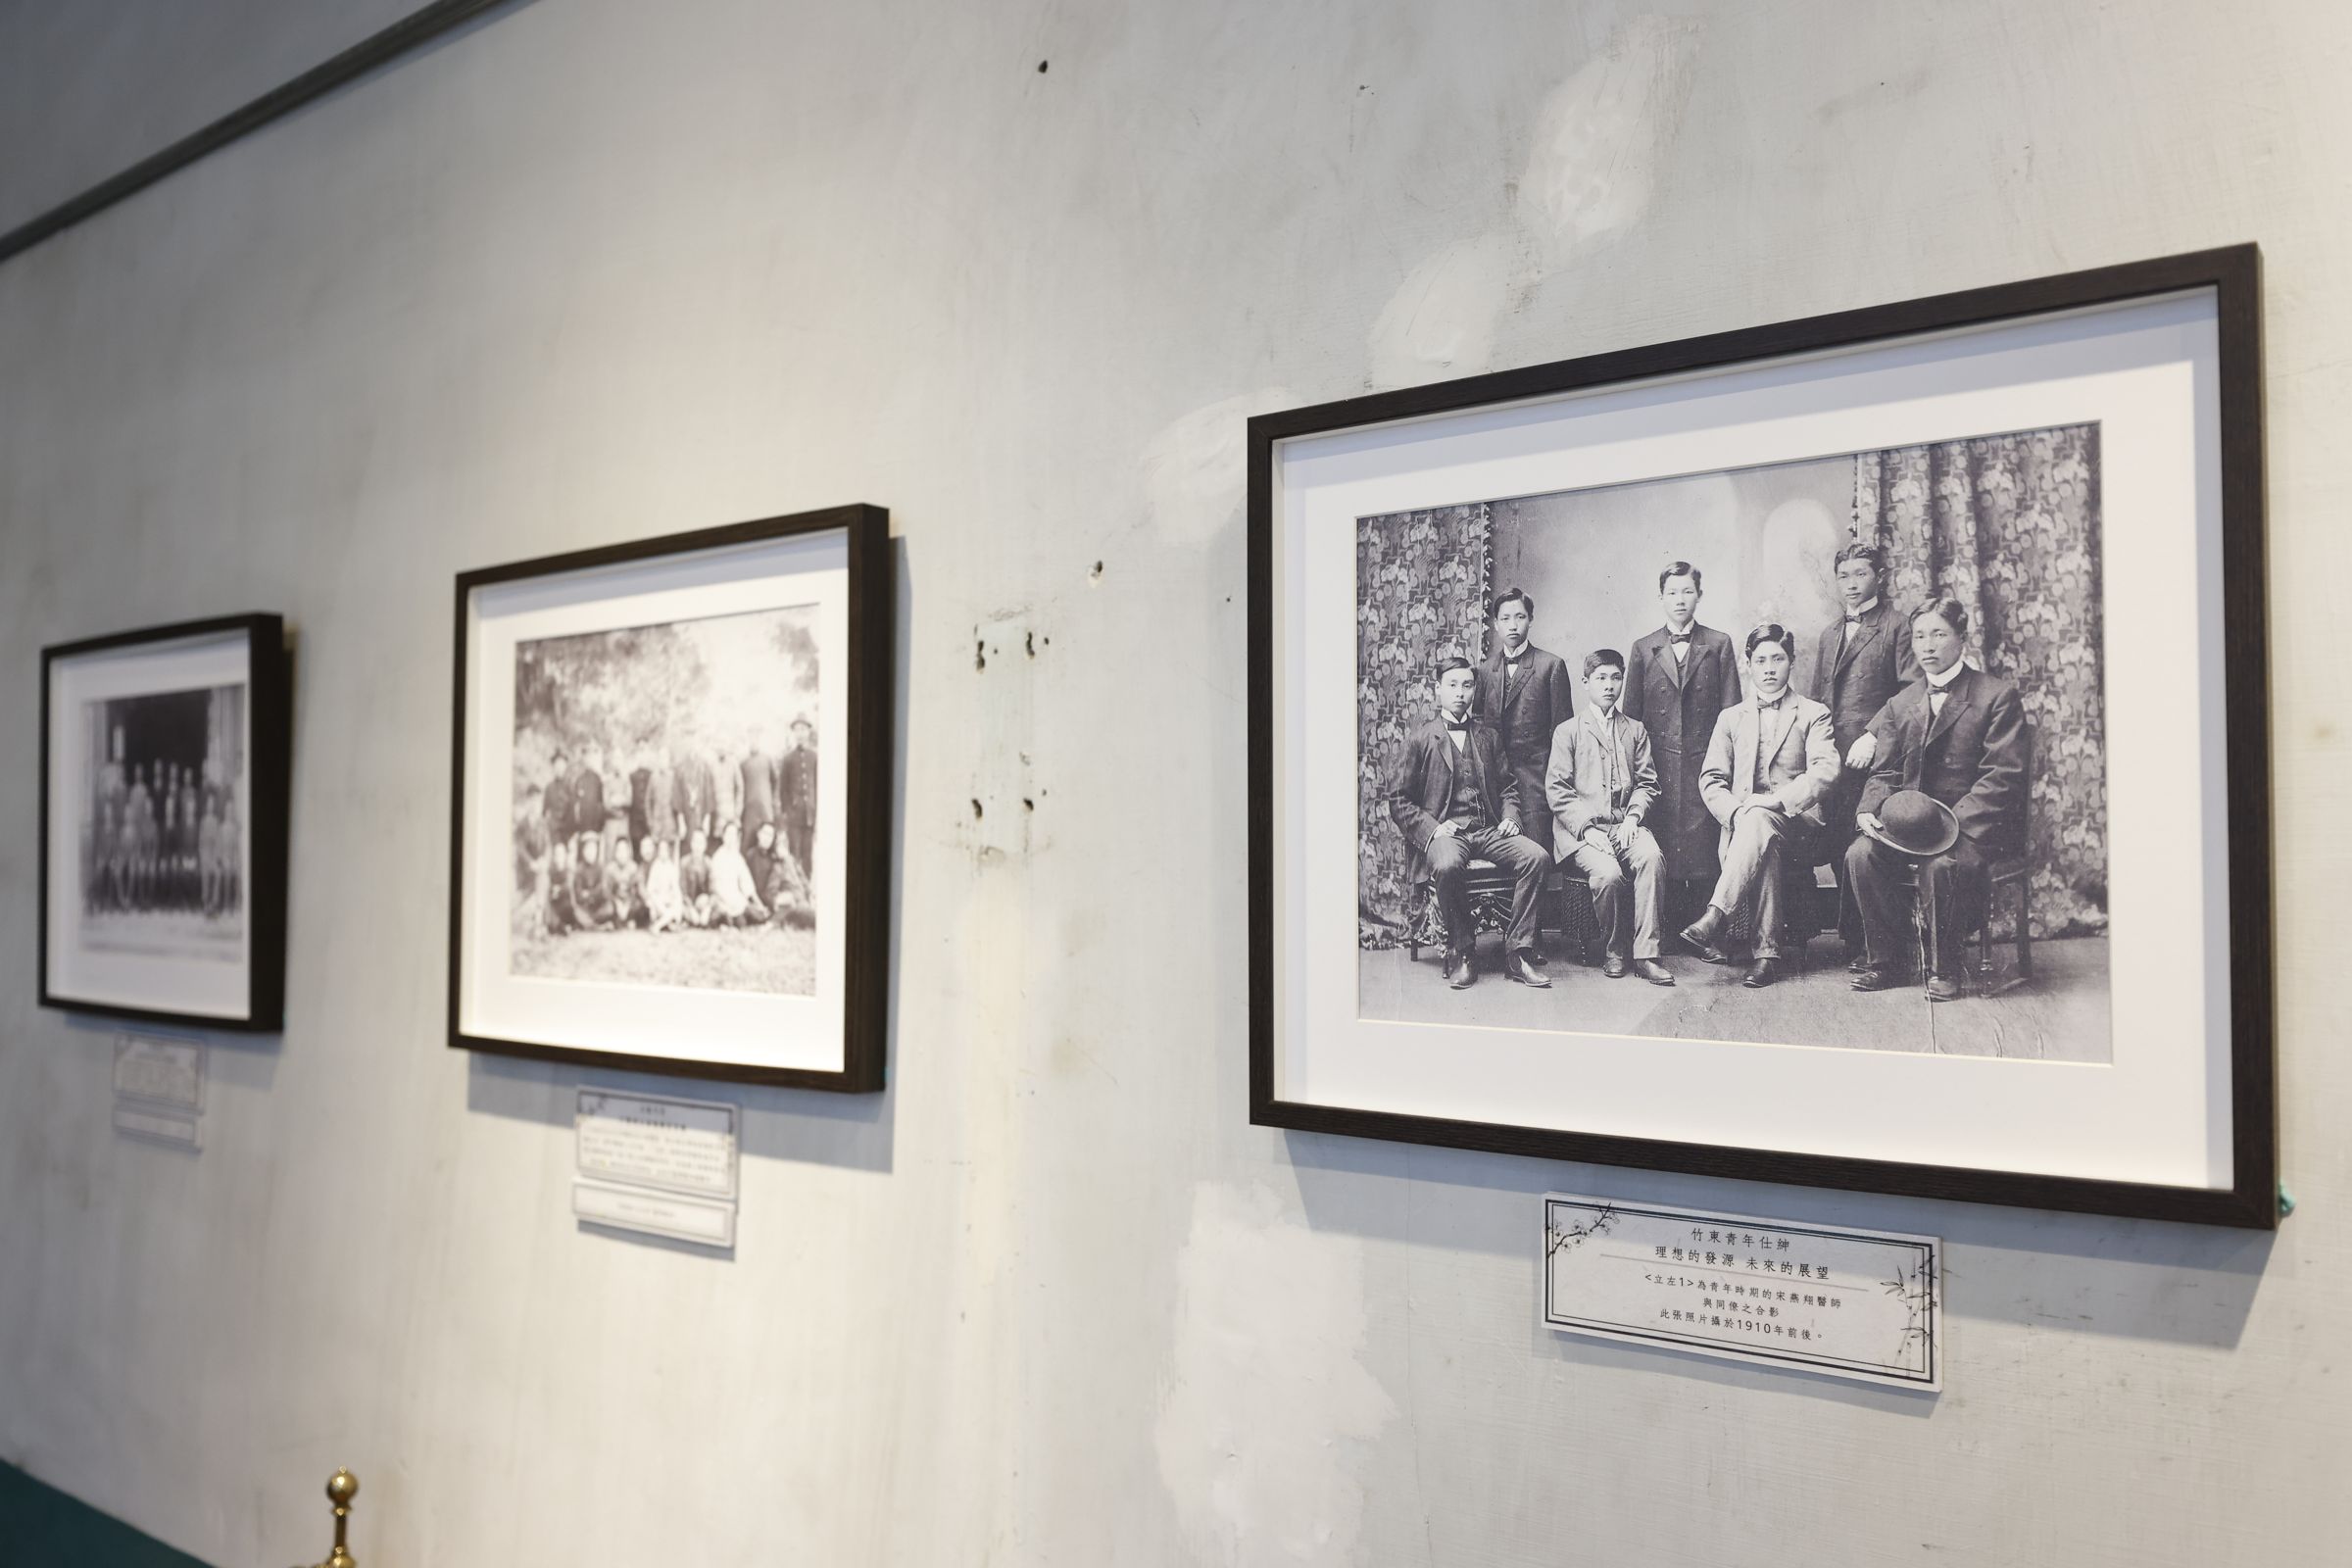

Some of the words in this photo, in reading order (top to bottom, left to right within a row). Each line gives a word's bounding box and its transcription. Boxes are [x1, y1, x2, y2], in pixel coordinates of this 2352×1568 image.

[1690, 1227, 1789, 1252] 竹東青年仕紳
[1655, 1246, 1735, 1267] 理想的發源
[1746, 1256, 1830, 1280] 未來的展望
